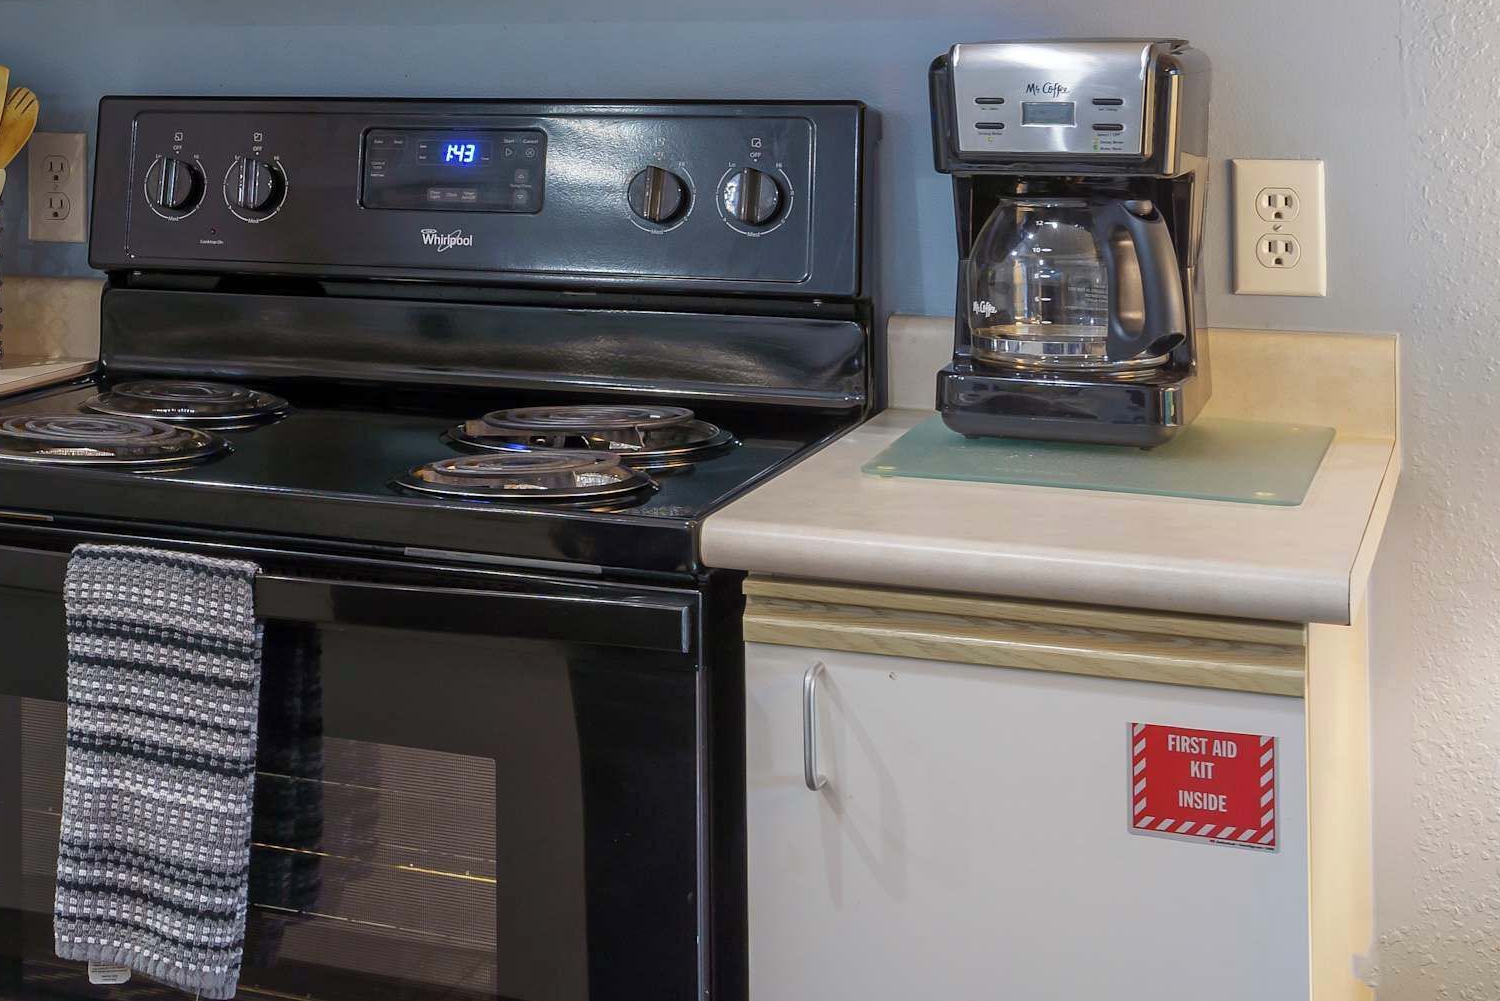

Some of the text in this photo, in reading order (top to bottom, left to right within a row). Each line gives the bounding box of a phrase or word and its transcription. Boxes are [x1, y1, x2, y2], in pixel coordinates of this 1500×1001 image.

[445, 144, 476, 163] 1:43
[421, 232, 473, 249] Whirlpool
[1167, 733, 1238, 759] FIRST AID
[1190, 760, 1216, 779] KIT
[1178, 789, 1229, 813] INSIDE
